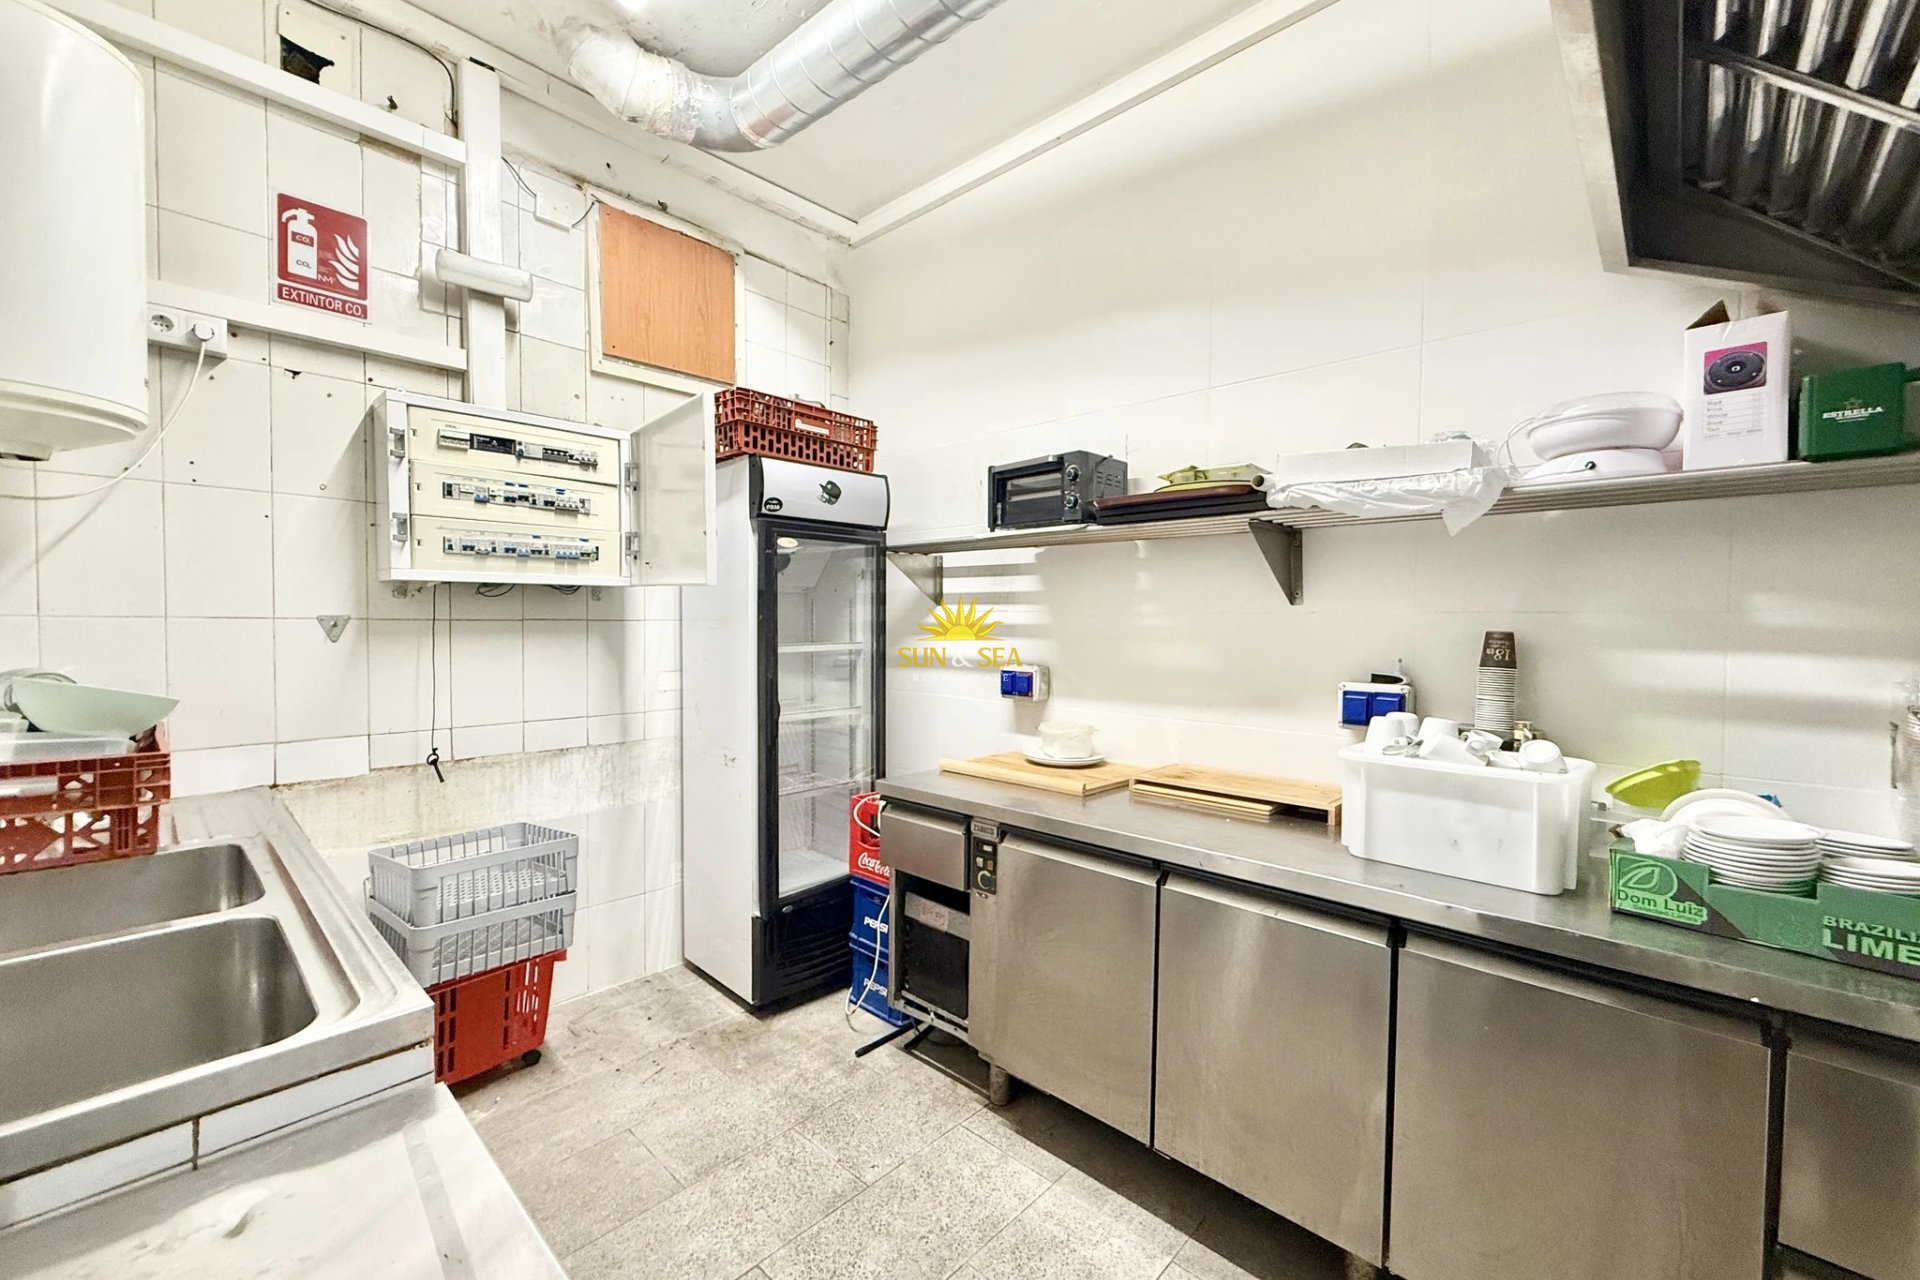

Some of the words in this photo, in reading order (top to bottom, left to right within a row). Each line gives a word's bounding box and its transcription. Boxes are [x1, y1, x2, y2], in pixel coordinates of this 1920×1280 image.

[282, 286, 342, 312] EXTINTOR
[1822, 406, 1884, 419] ESTRELLA
[1617, 889, 1657, 907] Dom
[1664, 899, 1704, 918] Luiz
[1822, 915, 1920, 944] BRAZILI
[1821, 928, 1920, 966] LIME
